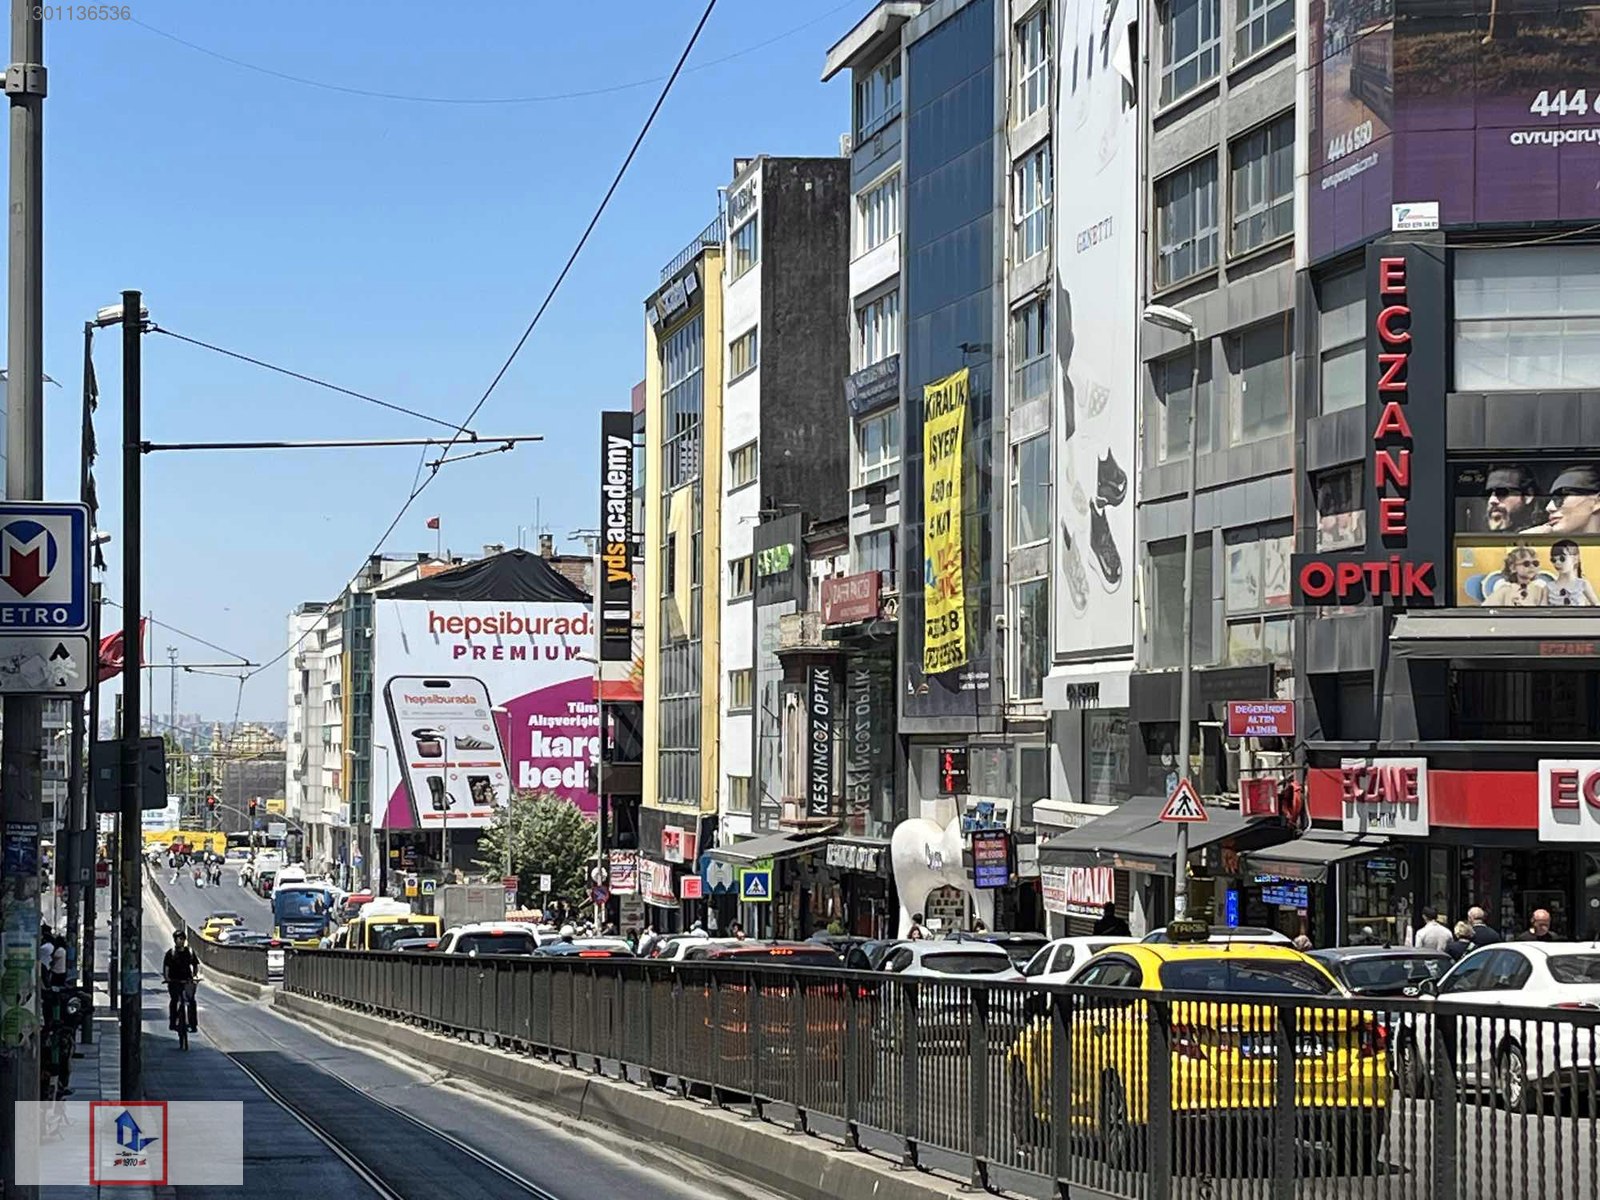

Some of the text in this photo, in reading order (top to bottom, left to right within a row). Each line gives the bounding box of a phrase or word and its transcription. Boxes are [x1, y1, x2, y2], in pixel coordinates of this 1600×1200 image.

[1530, 89, 1588, 117] 444
[1076, 215, 1113, 254] GENETTI
[1374, 257, 1413, 536] ECZANE
[603, 435, 633, 583] ydsacademy
[1299, 554, 1434, 598] OPTİK
[0, 608, 68, 623] ETRO
[452, 644, 581, 661] PREMIUM
[404, 694, 477, 706] hepsiburada
[567, 702, 598, 714] Tüm
